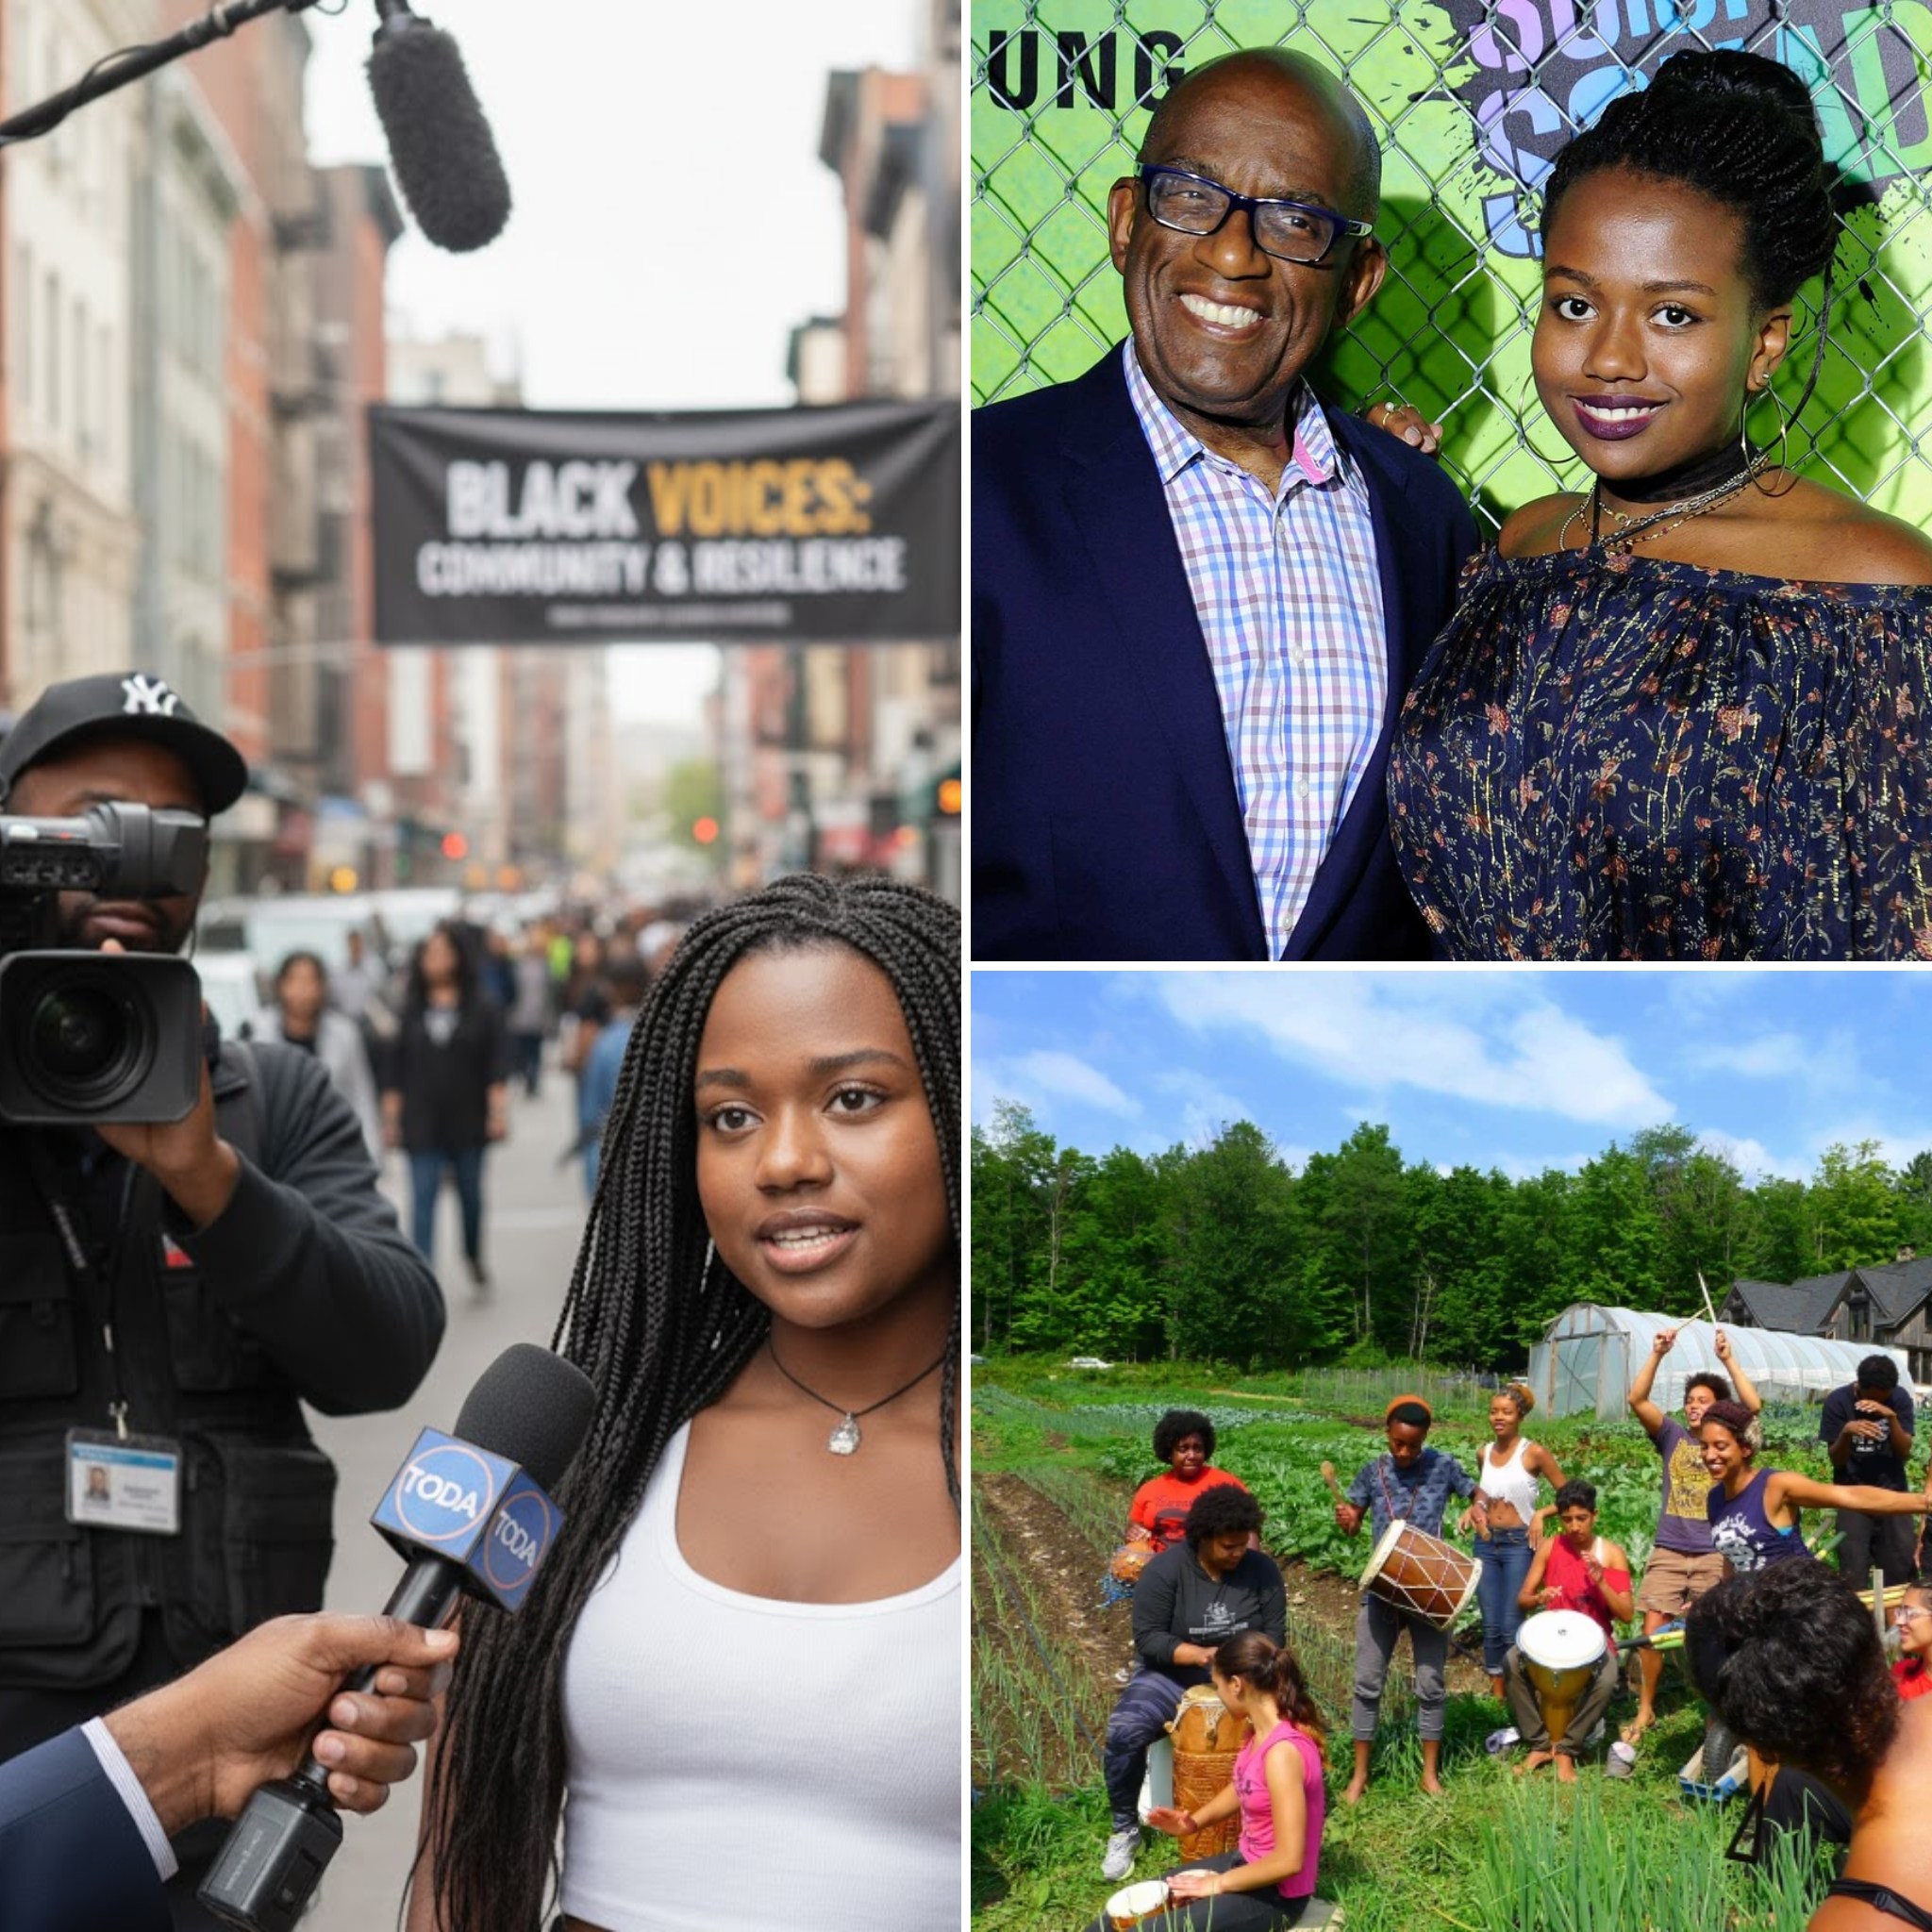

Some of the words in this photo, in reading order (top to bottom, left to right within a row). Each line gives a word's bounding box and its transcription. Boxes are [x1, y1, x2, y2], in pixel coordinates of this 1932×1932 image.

[447, 459, 639, 538] BLACK
[647, 457, 874, 536] VOICES:
[416, 540, 649, 595] COMMUNITY
[653, 541, 689, 595] &
[404, 1464, 478, 1520] TODA
[493, 1509, 538, 1568] TODA
